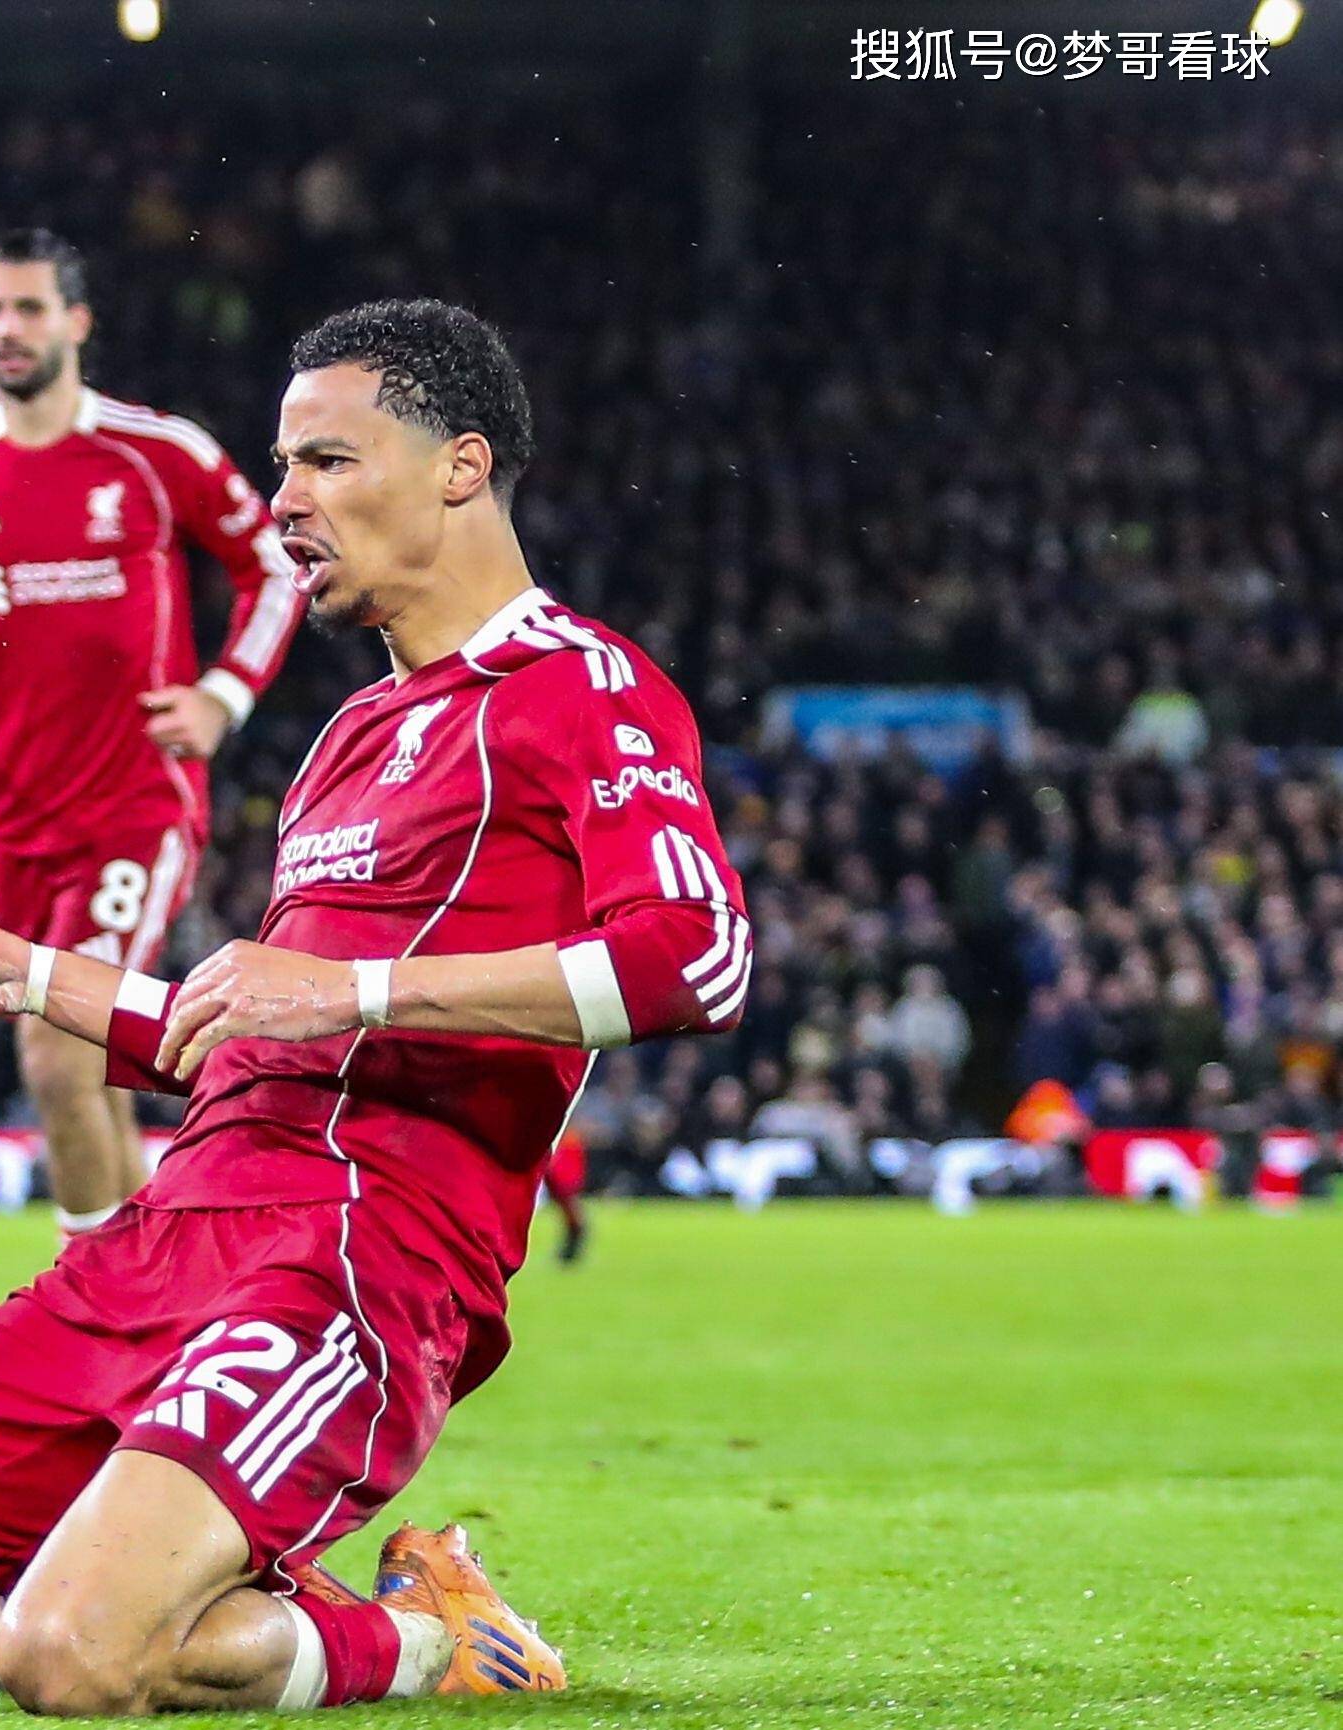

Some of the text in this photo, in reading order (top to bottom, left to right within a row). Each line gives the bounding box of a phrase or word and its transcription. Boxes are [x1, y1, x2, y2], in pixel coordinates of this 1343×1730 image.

[378, 765, 416, 785] LFC
[591, 765, 699, 809] Expedia
[89, 858, 148, 933] 8
